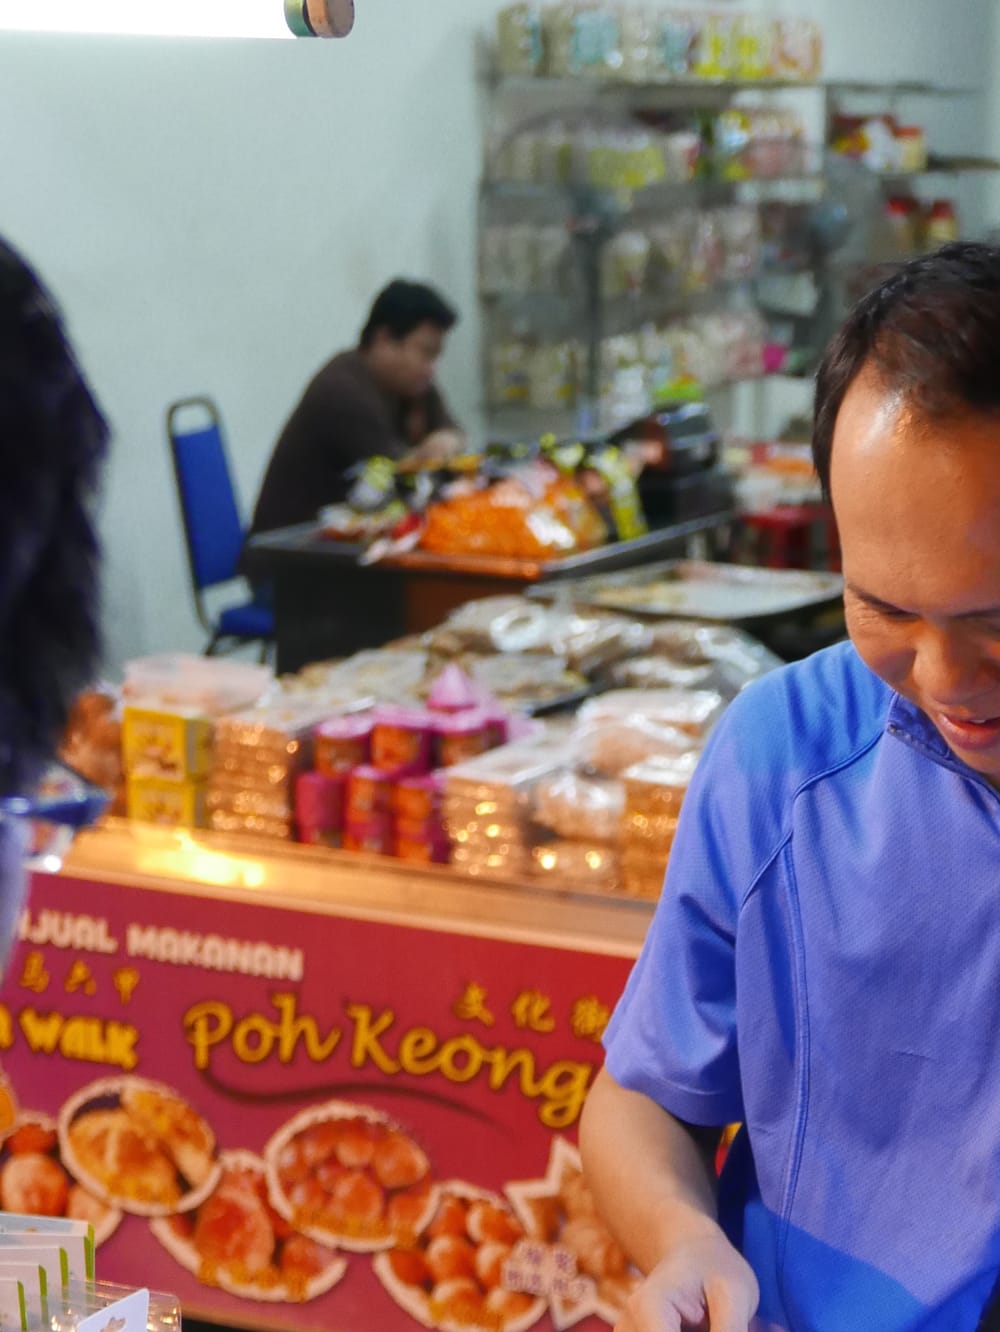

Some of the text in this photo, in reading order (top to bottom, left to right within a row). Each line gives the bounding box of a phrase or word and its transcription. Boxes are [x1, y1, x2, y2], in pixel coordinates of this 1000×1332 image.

[126, 923, 304, 981] MAKANAN
[184, 991, 593, 1128] Poh Keong
